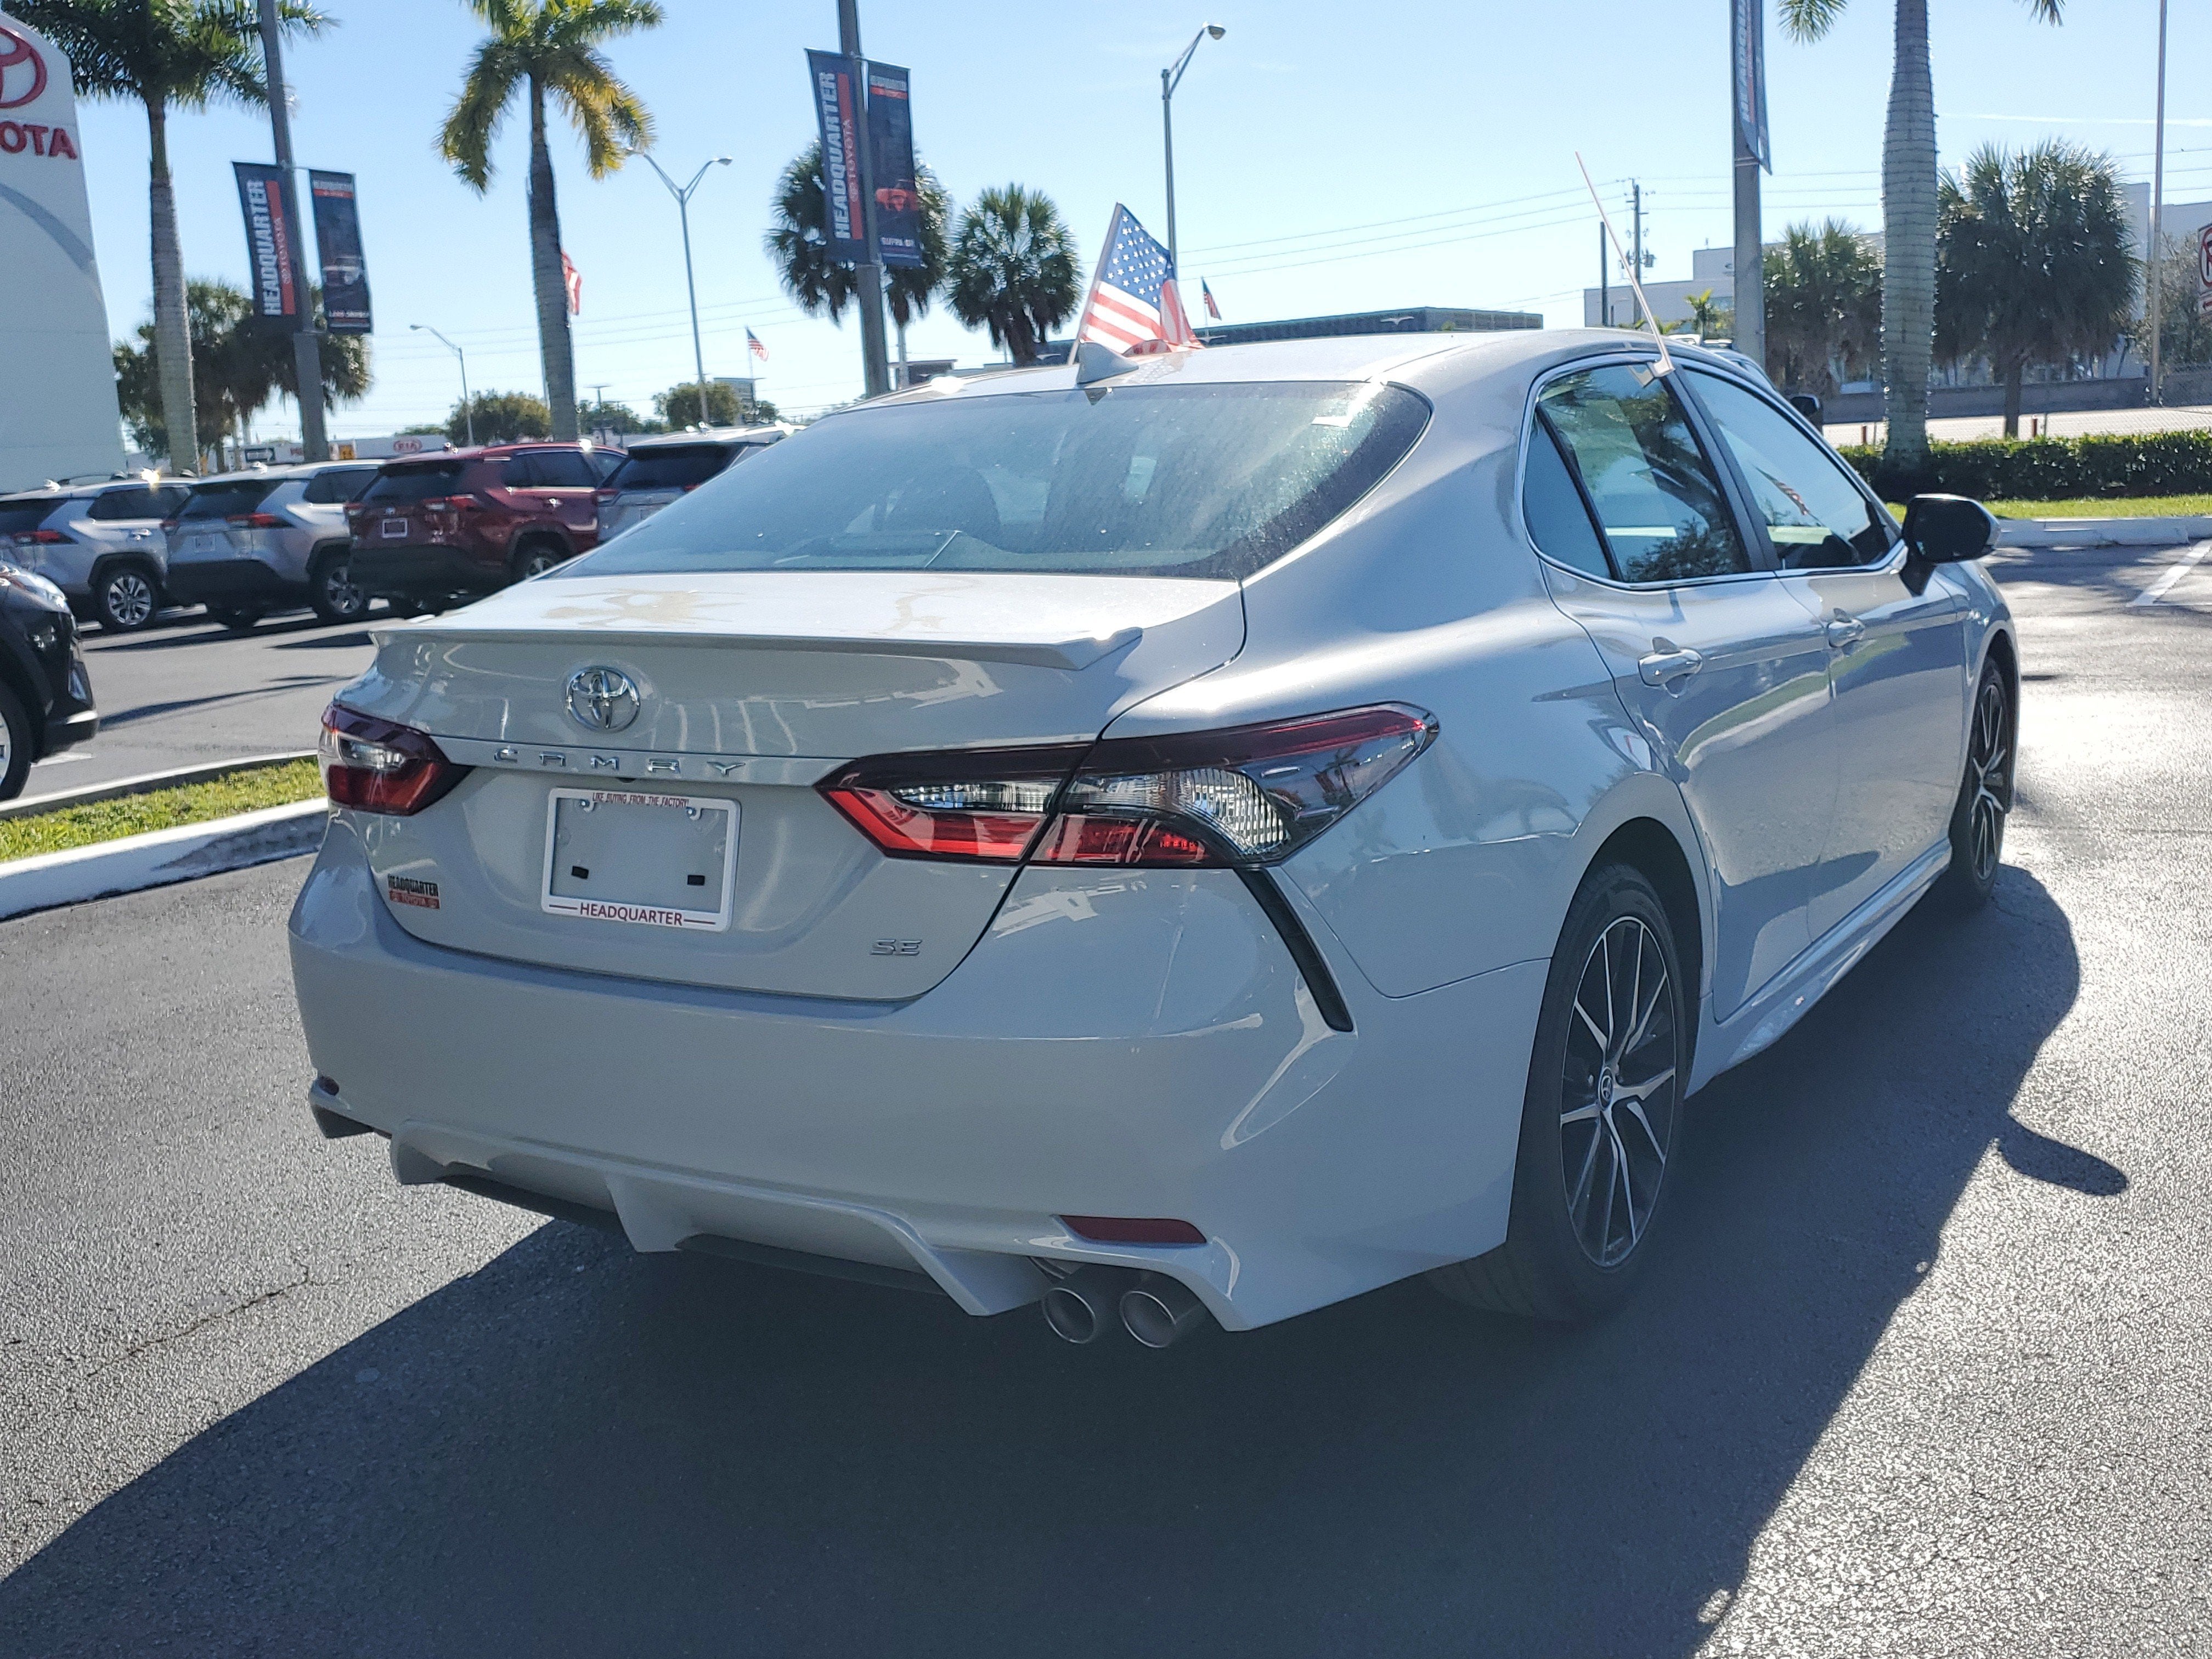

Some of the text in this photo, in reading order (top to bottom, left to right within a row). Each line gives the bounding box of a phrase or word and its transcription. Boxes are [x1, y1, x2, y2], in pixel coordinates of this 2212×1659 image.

[819, 72, 851, 239] HEADQUARTER
[246, 180, 282, 316] HEADQUARTER
[494, 747, 746, 777] CAMRY
[628, 794, 646, 805] FROM
[647, 796, 659, 805] THE
[388, 873, 438, 896] HEADQUARTER
[580, 902, 682, 926] HEADQUARTER
[870, 939, 922, 956] SE
